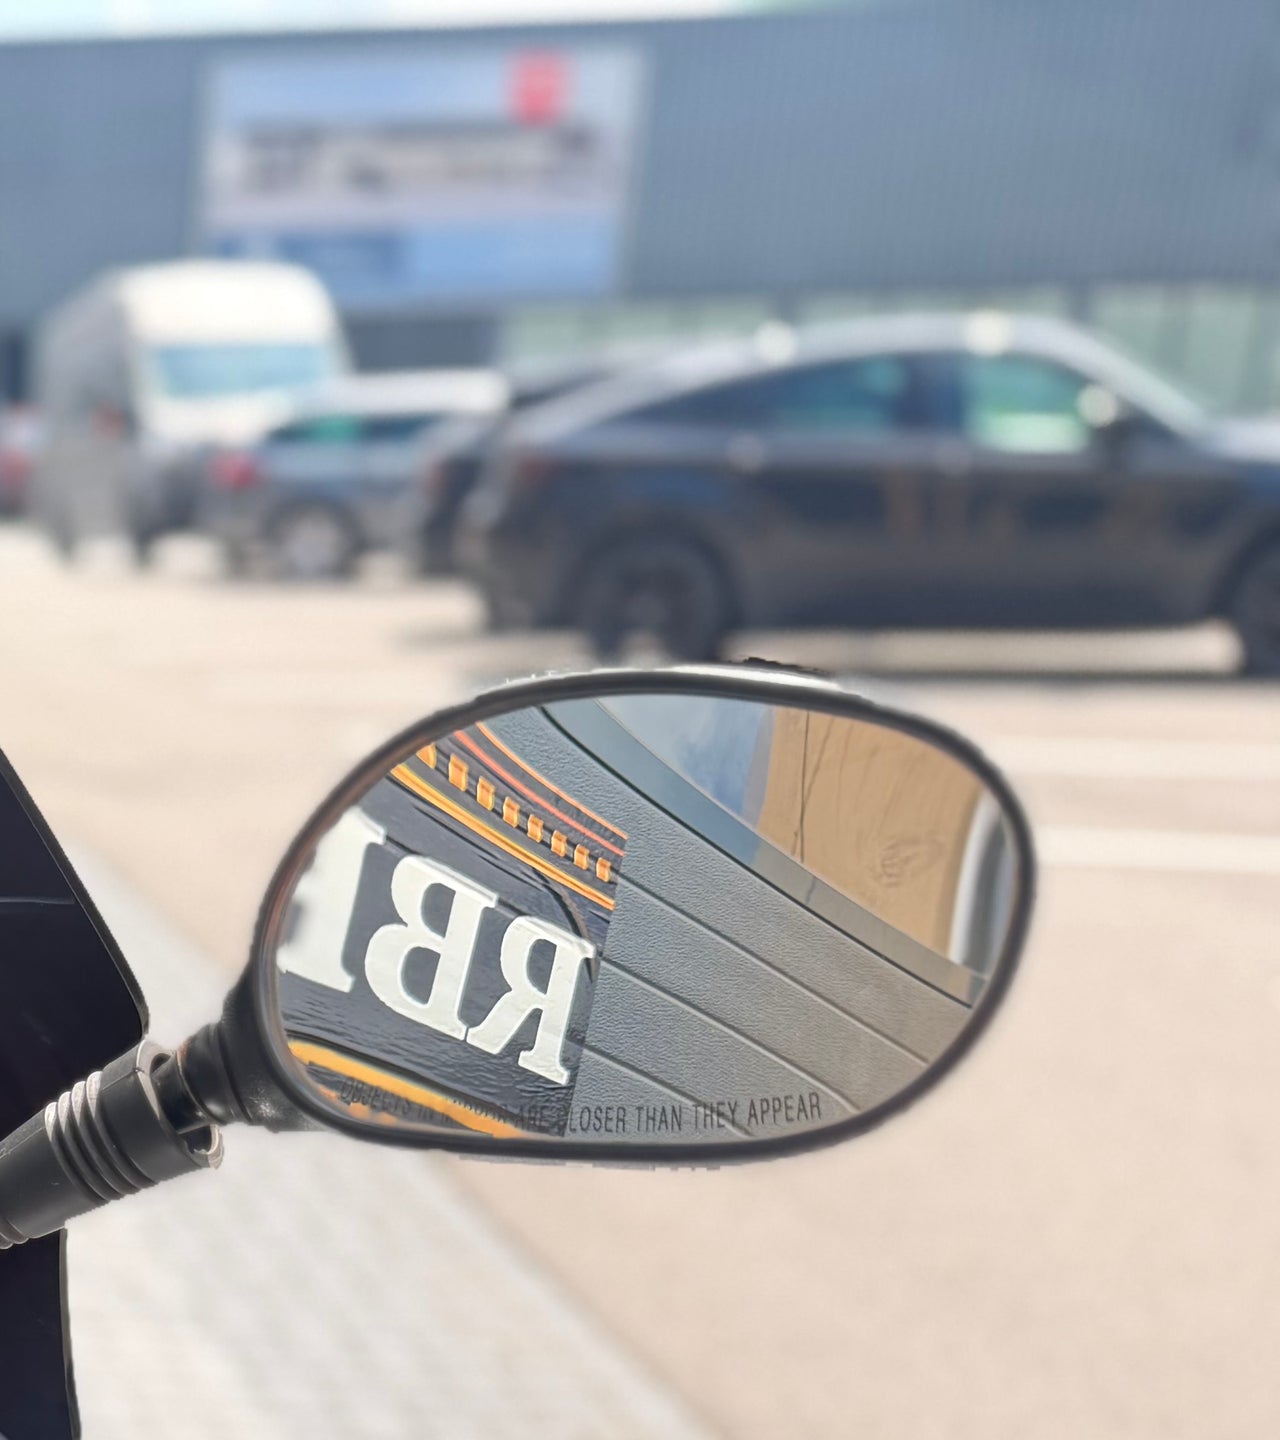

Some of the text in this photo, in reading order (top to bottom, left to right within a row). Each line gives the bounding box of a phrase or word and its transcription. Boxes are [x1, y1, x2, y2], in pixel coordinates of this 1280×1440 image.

[636, 1105, 683, 1133] THAN
[692, 1101, 738, 1130] THEY
[747, 1091, 822, 1128] APPEAR
